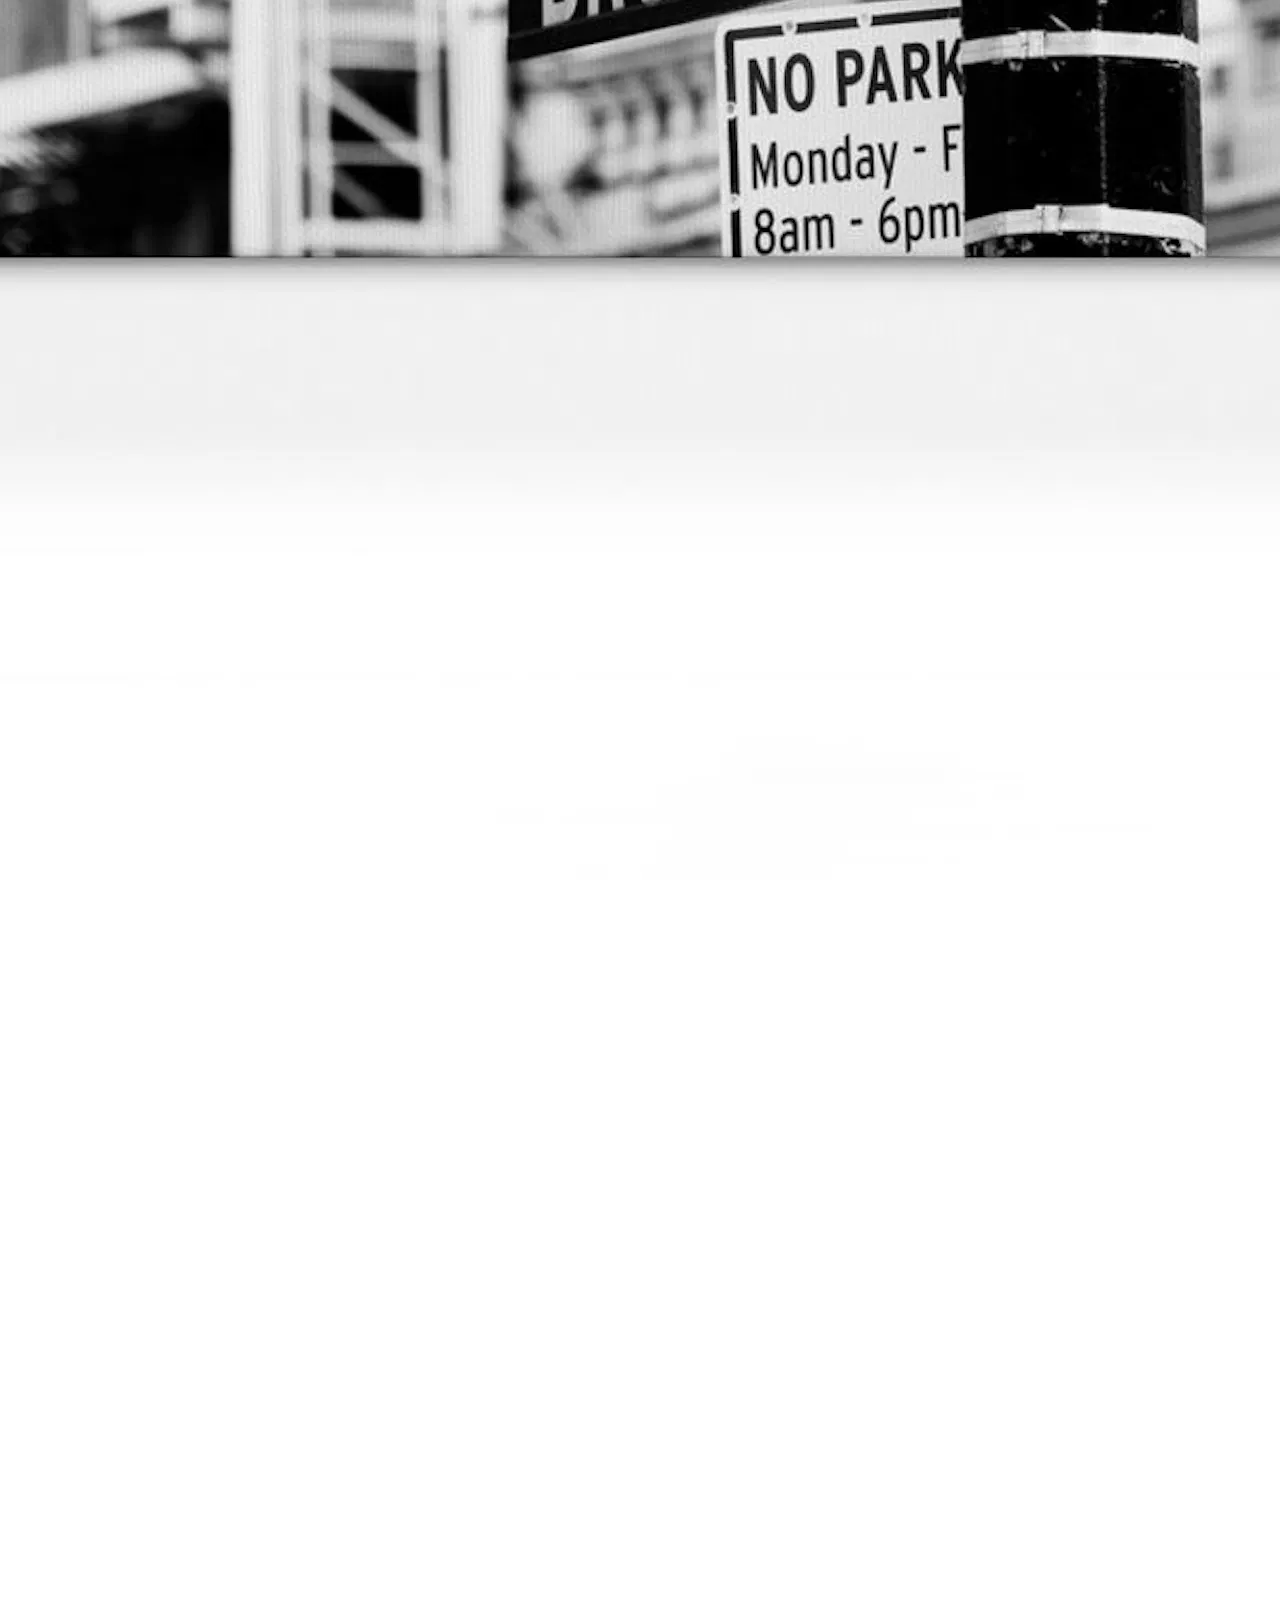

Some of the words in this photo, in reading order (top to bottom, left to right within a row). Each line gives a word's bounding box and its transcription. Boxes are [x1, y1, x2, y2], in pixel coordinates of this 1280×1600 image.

[748, 53, 815, 116] NO
[836, 38, 964, 107] PARK
[751, 134, 898, 190] Monday
[754, 208, 835, 254] 8am
[878, 197, 961, 253] 6pm
